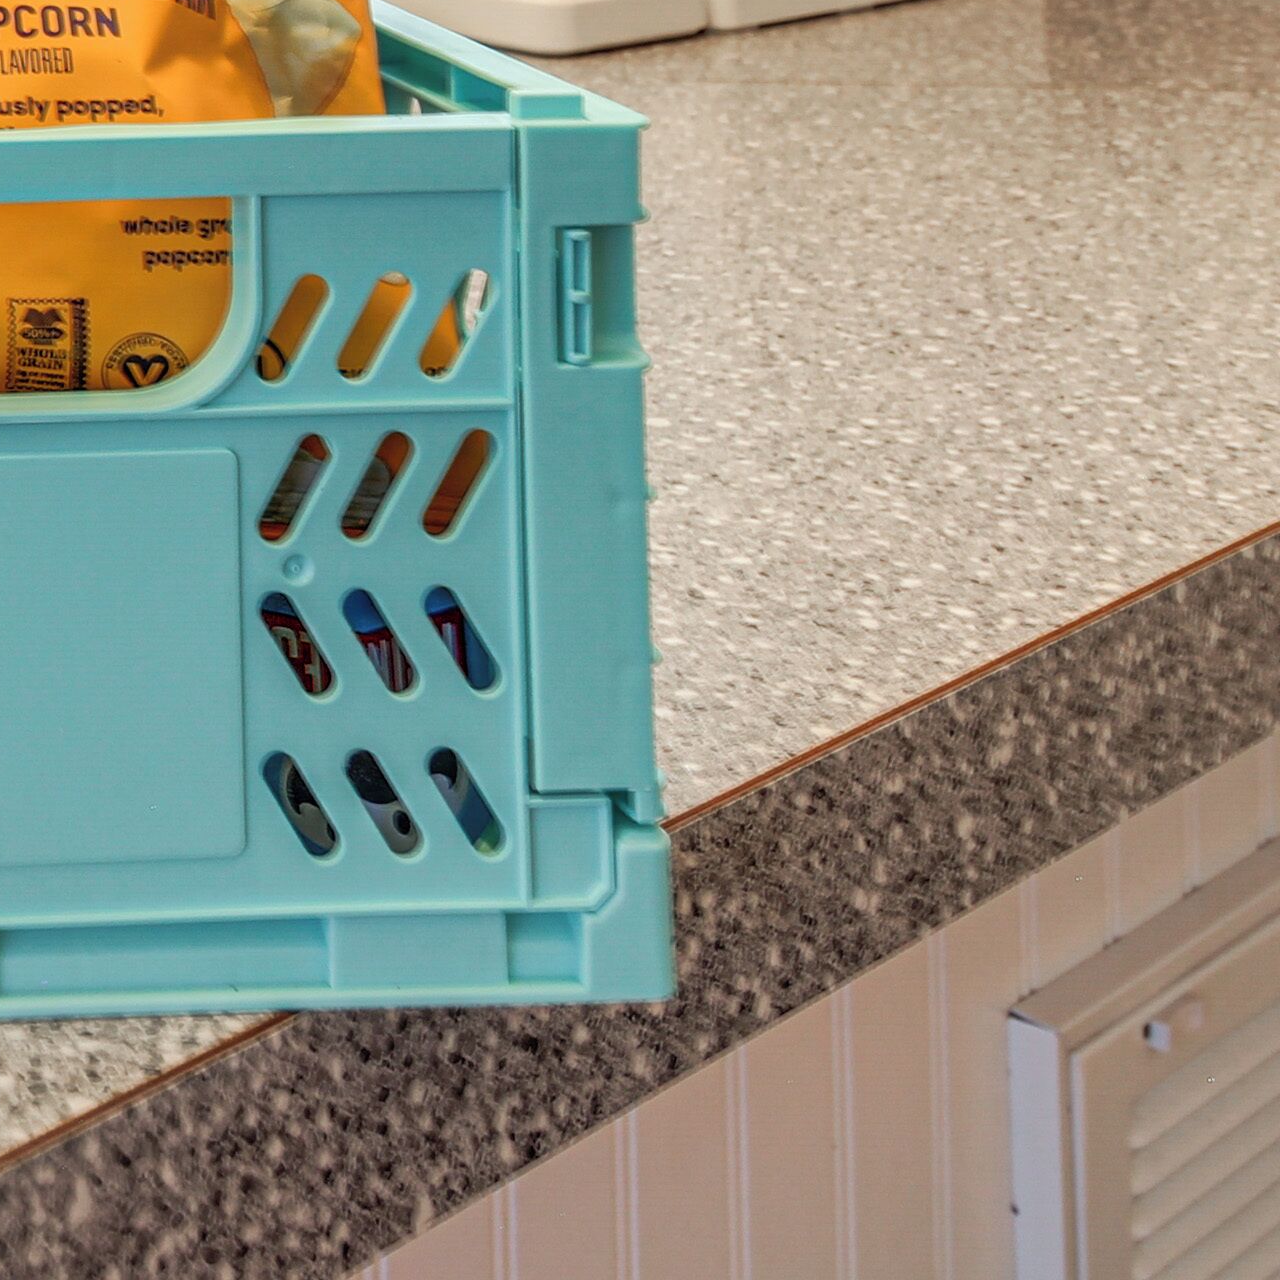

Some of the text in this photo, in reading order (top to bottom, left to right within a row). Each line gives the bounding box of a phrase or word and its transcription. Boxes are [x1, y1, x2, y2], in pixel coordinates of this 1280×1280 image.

[55, 95, 165, 122] popped,
[121, 215, 193, 236] whole
[17, 347, 67, 360] WHOLE
[17, 357, 64, 370] GRAIN
